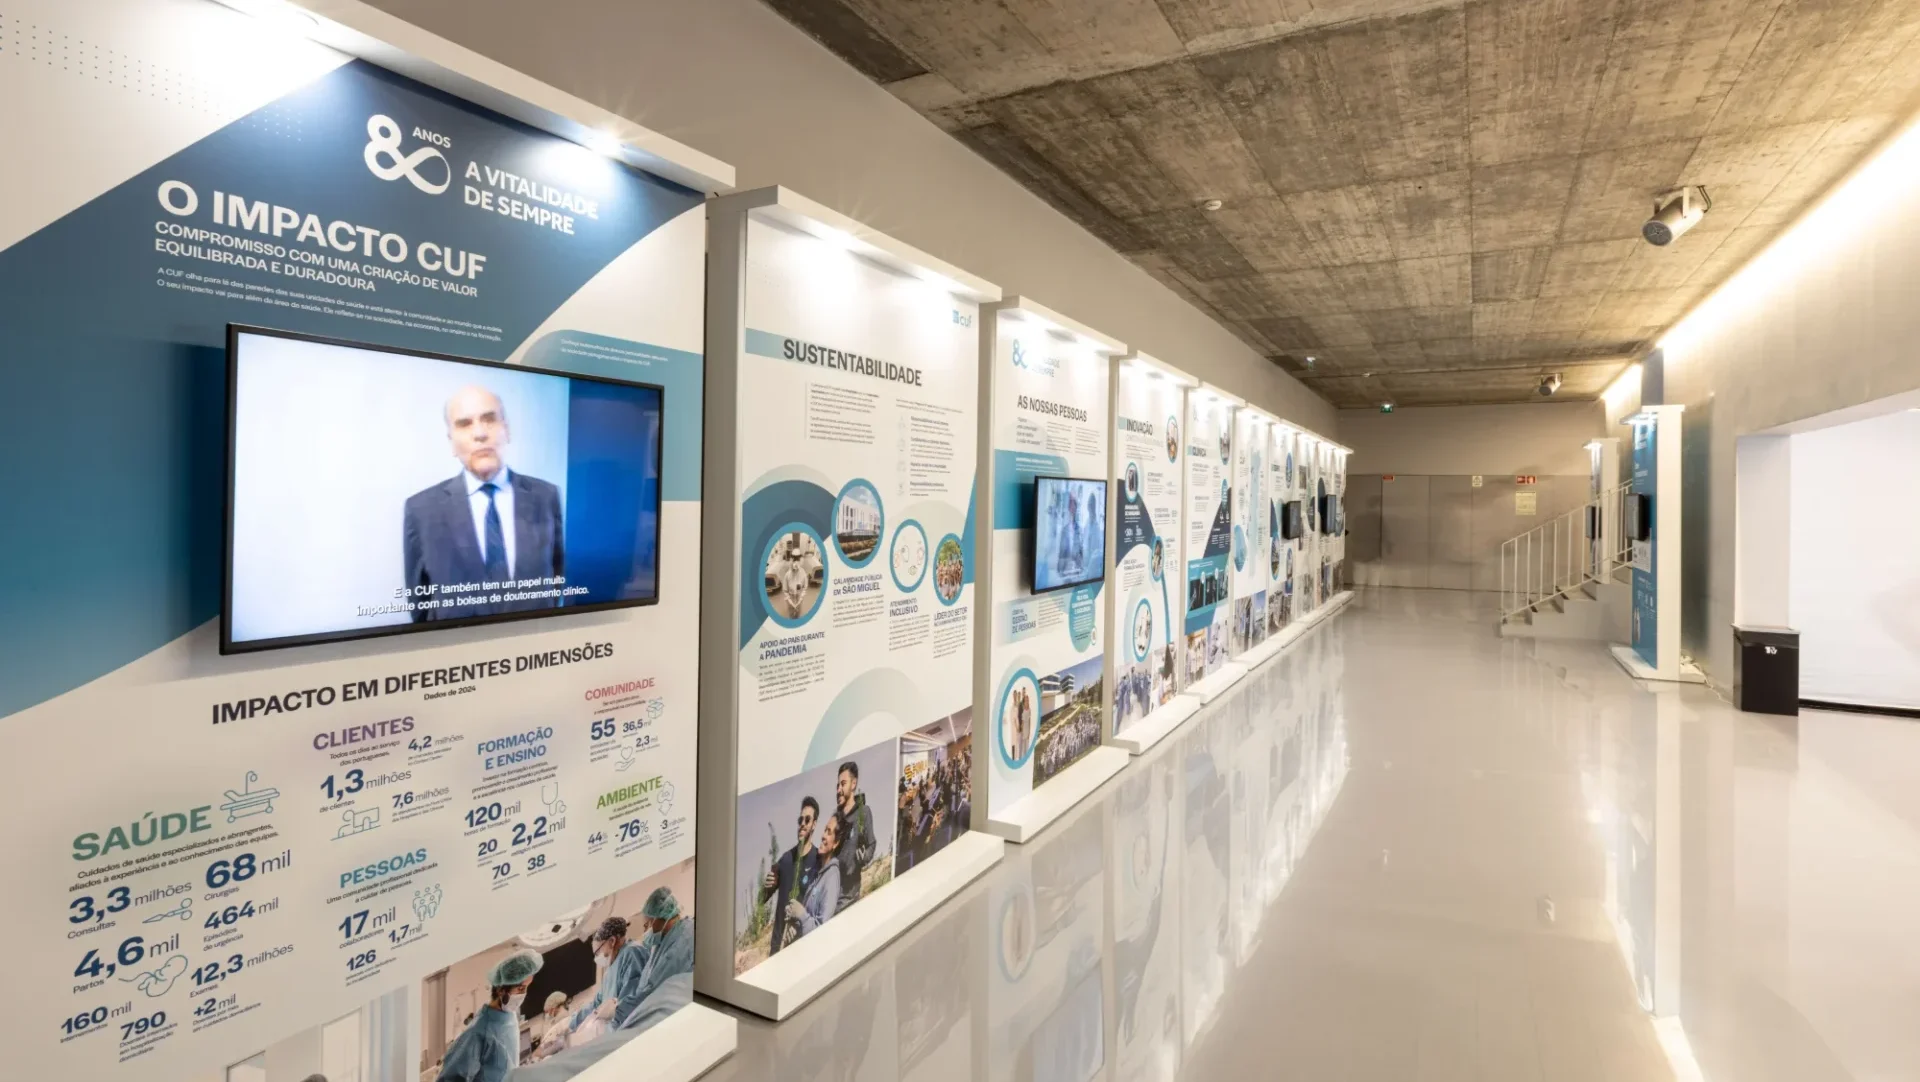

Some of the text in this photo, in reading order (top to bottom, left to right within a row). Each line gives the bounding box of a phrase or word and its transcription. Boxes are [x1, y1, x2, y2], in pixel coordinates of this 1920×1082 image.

[412, 126, 451, 148] ANOS
[465, 161, 599, 219] A VITALIDADE
[464, 185, 575, 235] DE SEMPRE
[157, 179, 487, 280] O IMPACTO CUF
[155, 221, 478, 298] COMPROMISSO COM UMA CRIAÇÃO DE VALOR
[155, 238, 376, 292] EQUILIBRADA E DURADOURA
[157, 267, 165, 275] A
[165, 268, 184, 278] CUF
[185, 271, 202, 281] olha
[203, 276, 221, 286] para
[230, 279, 244, 289] das
[245, 283, 274, 294] paredes
[783, 338, 922, 387] SUSTENTABILIDADE
[1017, 395, 1088, 422] AS NOSSAS PESSOAS
[393, 574, 566, 600] E a CUF também tem um papel muito
[417, 600, 440, 610] com
[442, 598, 455, 608] as
[456, 594, 488, 606] bolsas
[489, 592, 502, 603] de
[503, 588, 561, 602] doutoramento
[562, 586, 590, 597] clínico.
[833, 581, 880, 596] EM SÃO MIGUEL
[889, 604, 919, 617] INCLUSIVO
[759, 639, 778, 649] APOIO
[800, 631, 825, 642] DURANTE
[759, 643, 807, 661] A PANDEMIA
[212, 642, 614, 724] IMPACTO EM DIFERENTES DIMENSÕES
[423, 684, 477, 700] Dados de 2024
[584, 677, 655, 701] COMUNIDADE
[313, 716, 415, 751] CLIENTES
[591, 717, 616, 741] 55
[622, 718, 644, 734] 36,5
[330, 751, 348, 760] Todos
[379, 740, 400, 749] serviço
[408, 734, 464, 752] 4,2 milhões
[477, 726, 553, 755] FORMAÇÃO
[635, 735, 650, 748] 2,3
[340, 759, 351, 767] dos
[485, 744, 547, 770] E ENSINO
[320, 768, 412, 802] 1,3 milhões
[596, 775, 663, 810] AMBIENTE
[329, 800, 355, 811] clientes
[392, 791, 413, 809] 7,6
[415, 787, 449, 802] milhões
[464, 802, 502, 828] 120
[504, 800, 521, 817] mil
[71, 805, 212, 861] SAÚDE
[463, 828, 479, 837] horas
[486, 817, 511, 829] formação
[511, 816, 566, 846] 2,2 mil
[77, 863, 121, 879] Cuidados
[122, 859, 133, 868] de
[162, 836, 219, 857] especializados
[227, 823, 273, 840] abrangentes,
[477, 838, 498, 857] 20
[69, 877, 102, 892] aliados
[103, 875, 109, 883] à
[110, 863, 160, 881] experiência
[168, 858, 179, 866] ao
[180, 843, 234, 862] conhecimento
[235, 839, 249, 848] das
[205, 849, 291, 889] 68 mil
[339, 848, 427, 889] PESSOAS
[492, 862, 511, 880] 70
[527, 853, 545, 871] 38
[68, 881, 192, 925] 3,3 milhões
[203, 885, 240, 902] Cirurgias
[203, 897, 279, 930] 464 mil
[338, 906, 396, 939] 17 mil
[67, 920, 117, 940] Consultas
[203, 927, 237, 943] Episódios
[339, 928, 385, 949] colaboradores
[388, 923, 423, 944] 1,7 mil
[203, 933, 244, 952] de urgência
[74, 933, 180, 979] 4,6 mil
[190, 943, 294, 987] 12,3 milhões
[346, 949, 376, 971] 126
[72, 978, 105, 994] Partos
[189, 983, 219, 998] Exames
[193, 993, 236, 1016] +2 mil
[60, 1001, 132, 1034] 160 mil
[120, 1010, 166, 1041] 790
[60, 1023, 108, 1043] Internamentos
